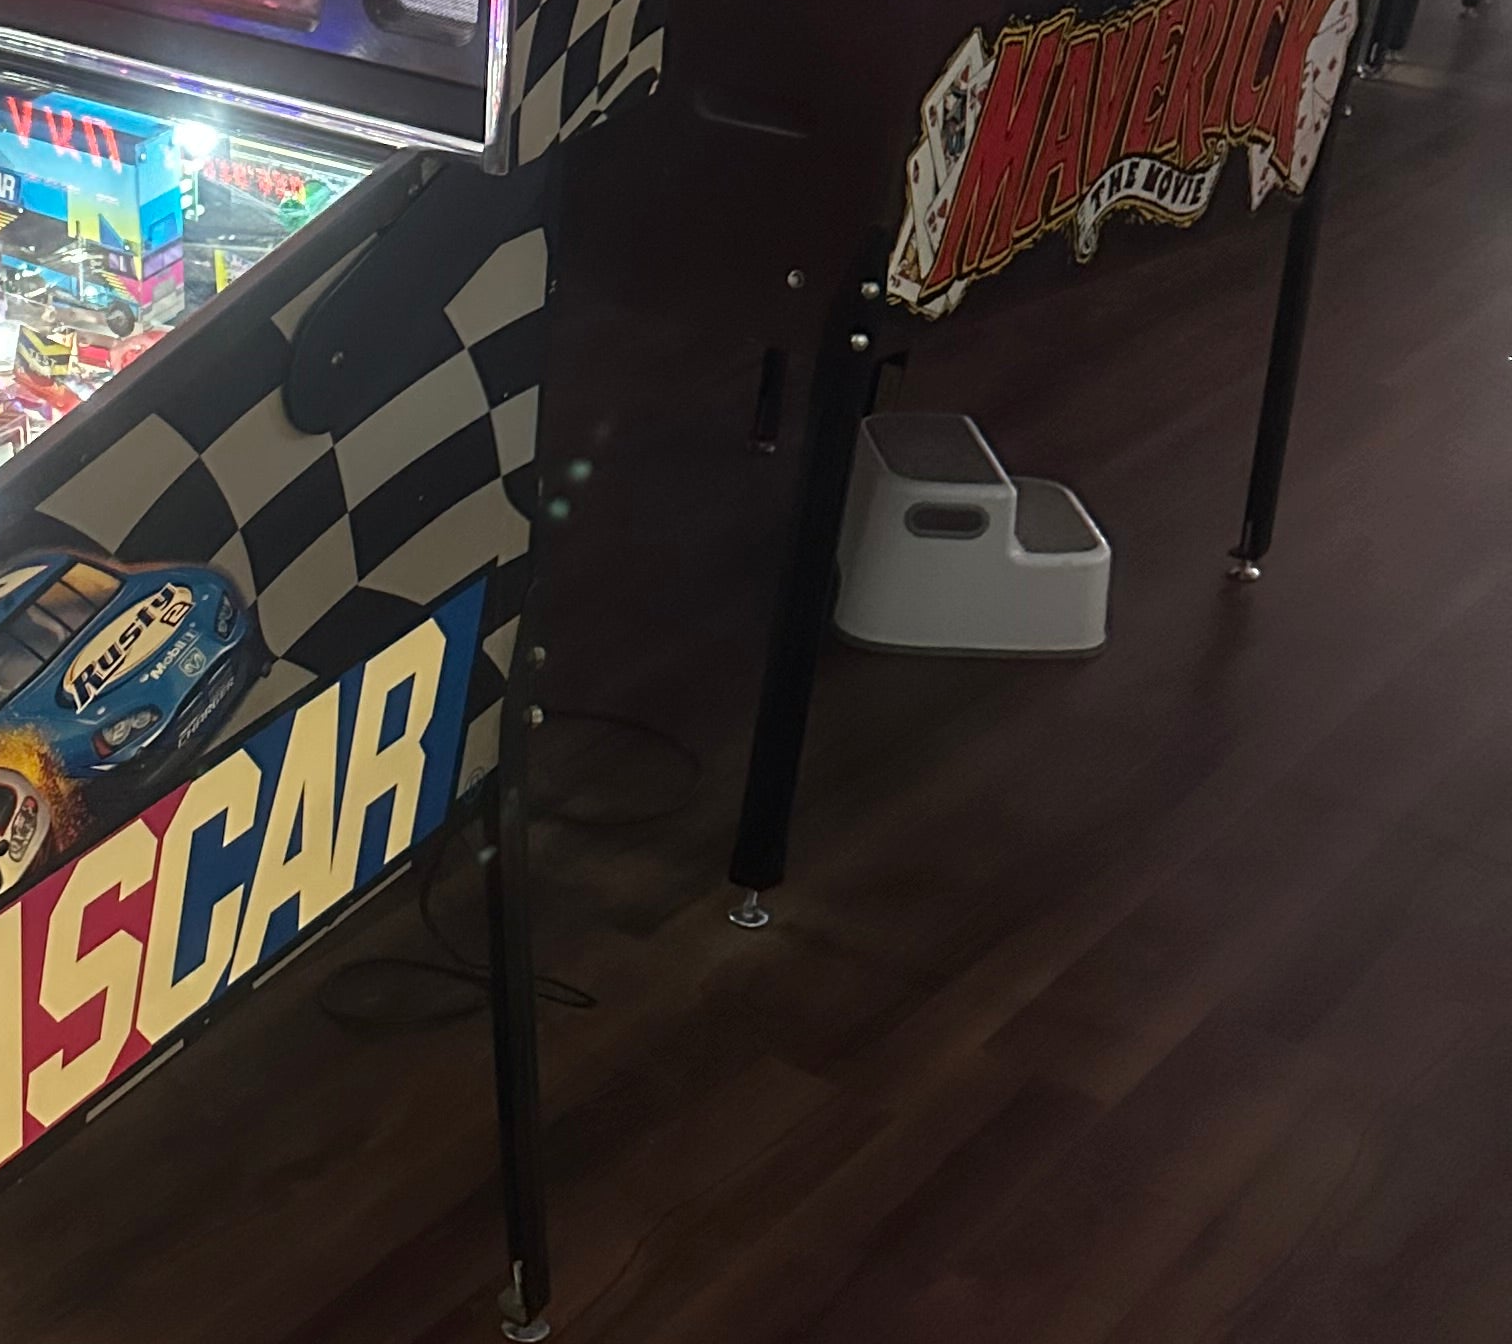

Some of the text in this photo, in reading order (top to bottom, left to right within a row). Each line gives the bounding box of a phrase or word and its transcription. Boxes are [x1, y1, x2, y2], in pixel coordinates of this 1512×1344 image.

[1090, 161, 1207, 212] THE MOVIE
[71, 582, 178, 715] Rusty
[148, 639, 188, 682] Mobil
